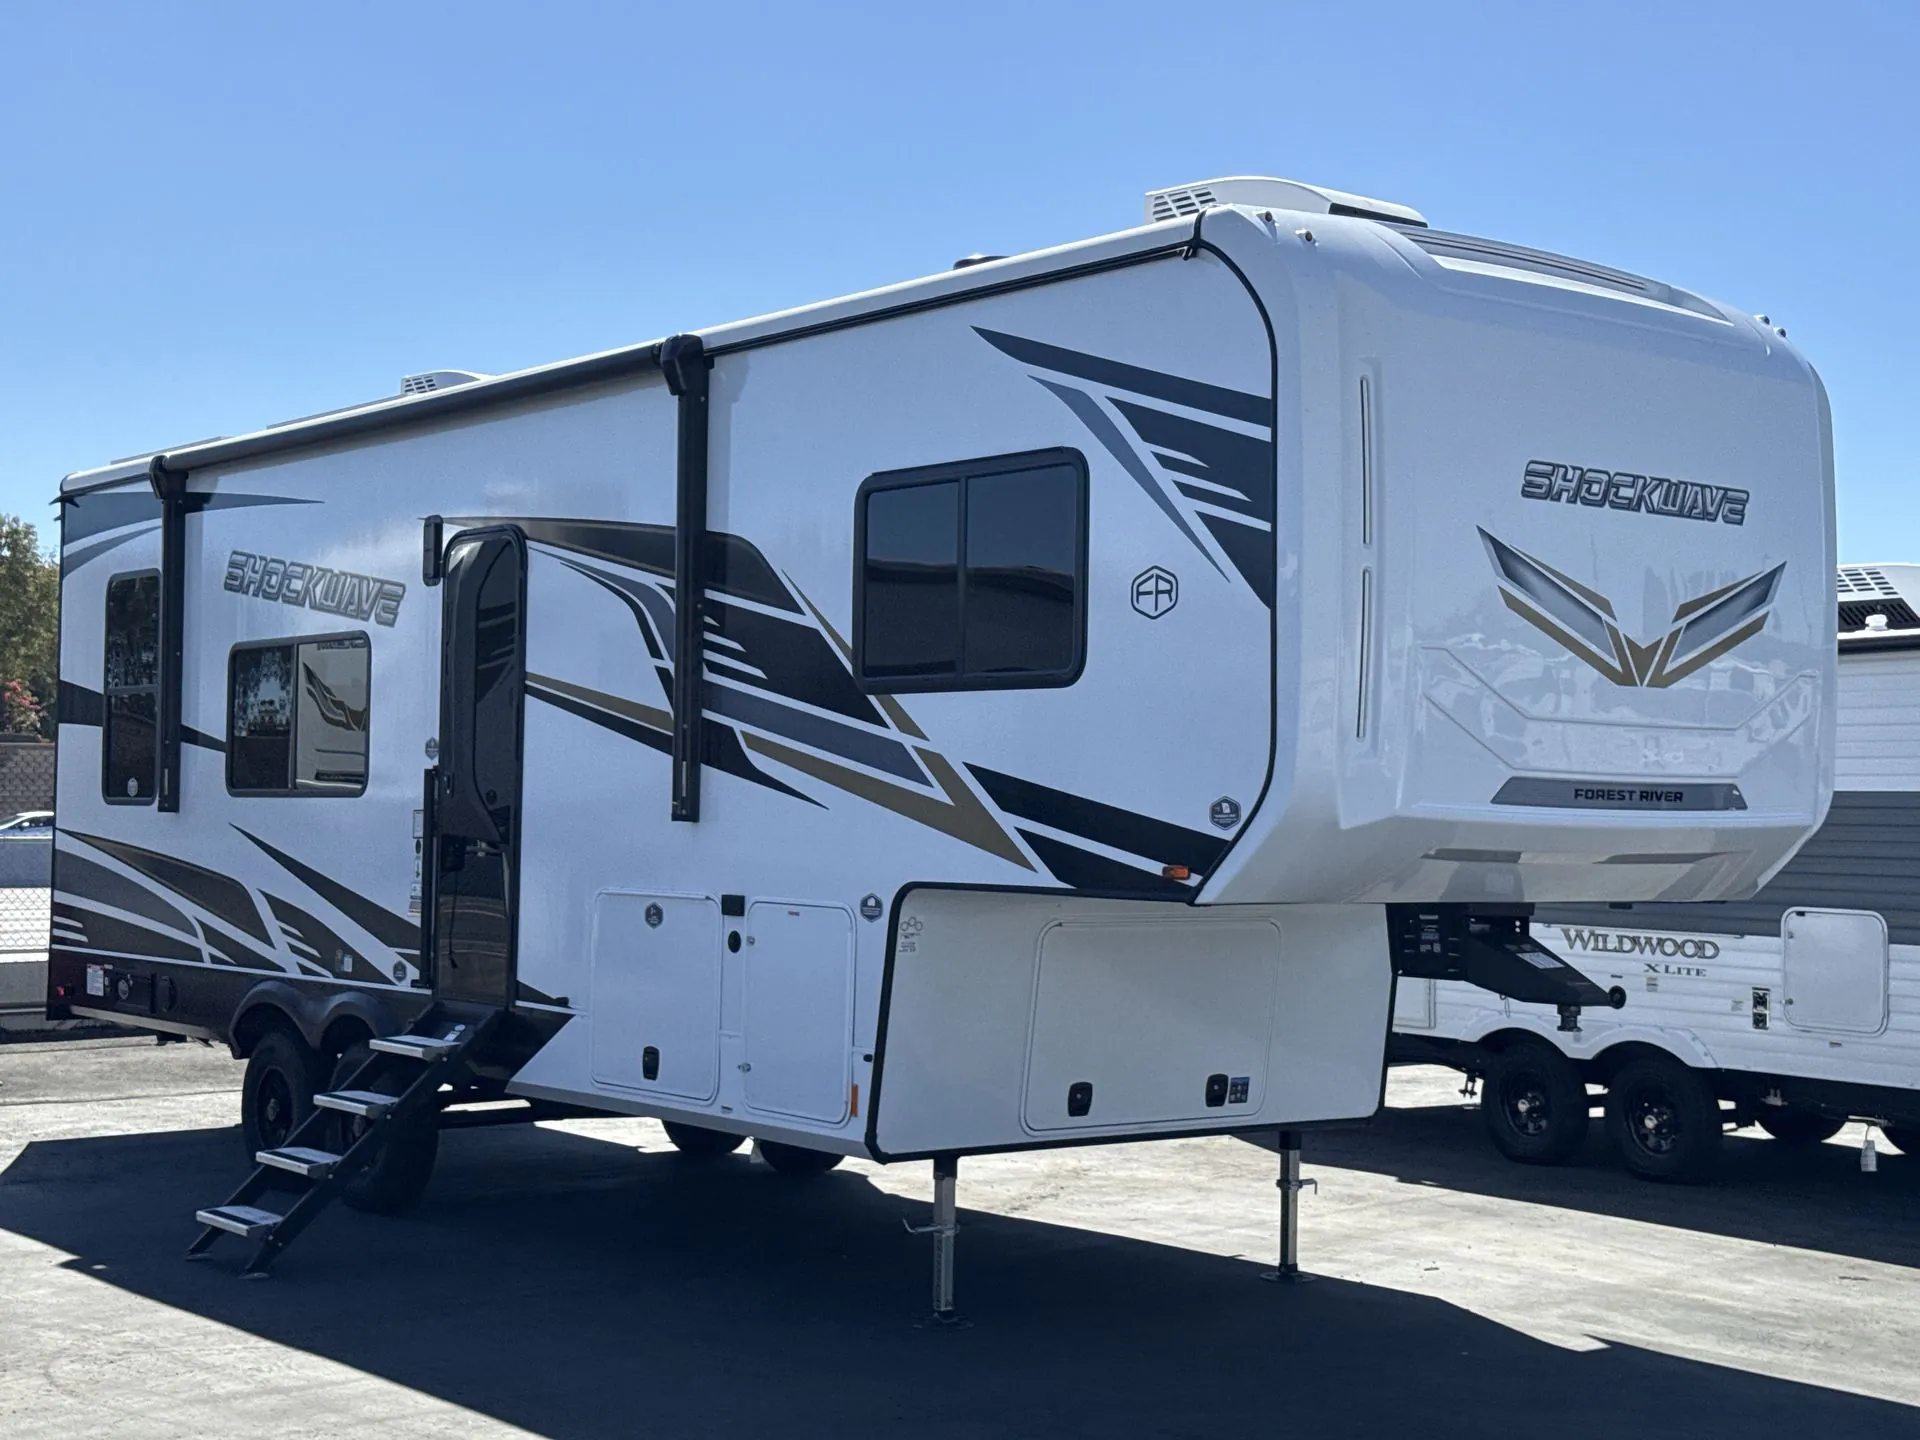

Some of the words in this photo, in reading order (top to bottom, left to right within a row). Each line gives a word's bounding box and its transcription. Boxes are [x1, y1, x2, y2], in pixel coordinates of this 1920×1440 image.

[1521, 459, 1749, 525] SHOCKWAVE
[224, 550, 406, 627] SHOCKWAVE
[1574, 788, 1636, 801] FOREST
[1639, 790, 1683, 803] RIVER
[1561, 927, 1720, 959] WILDWOOD
